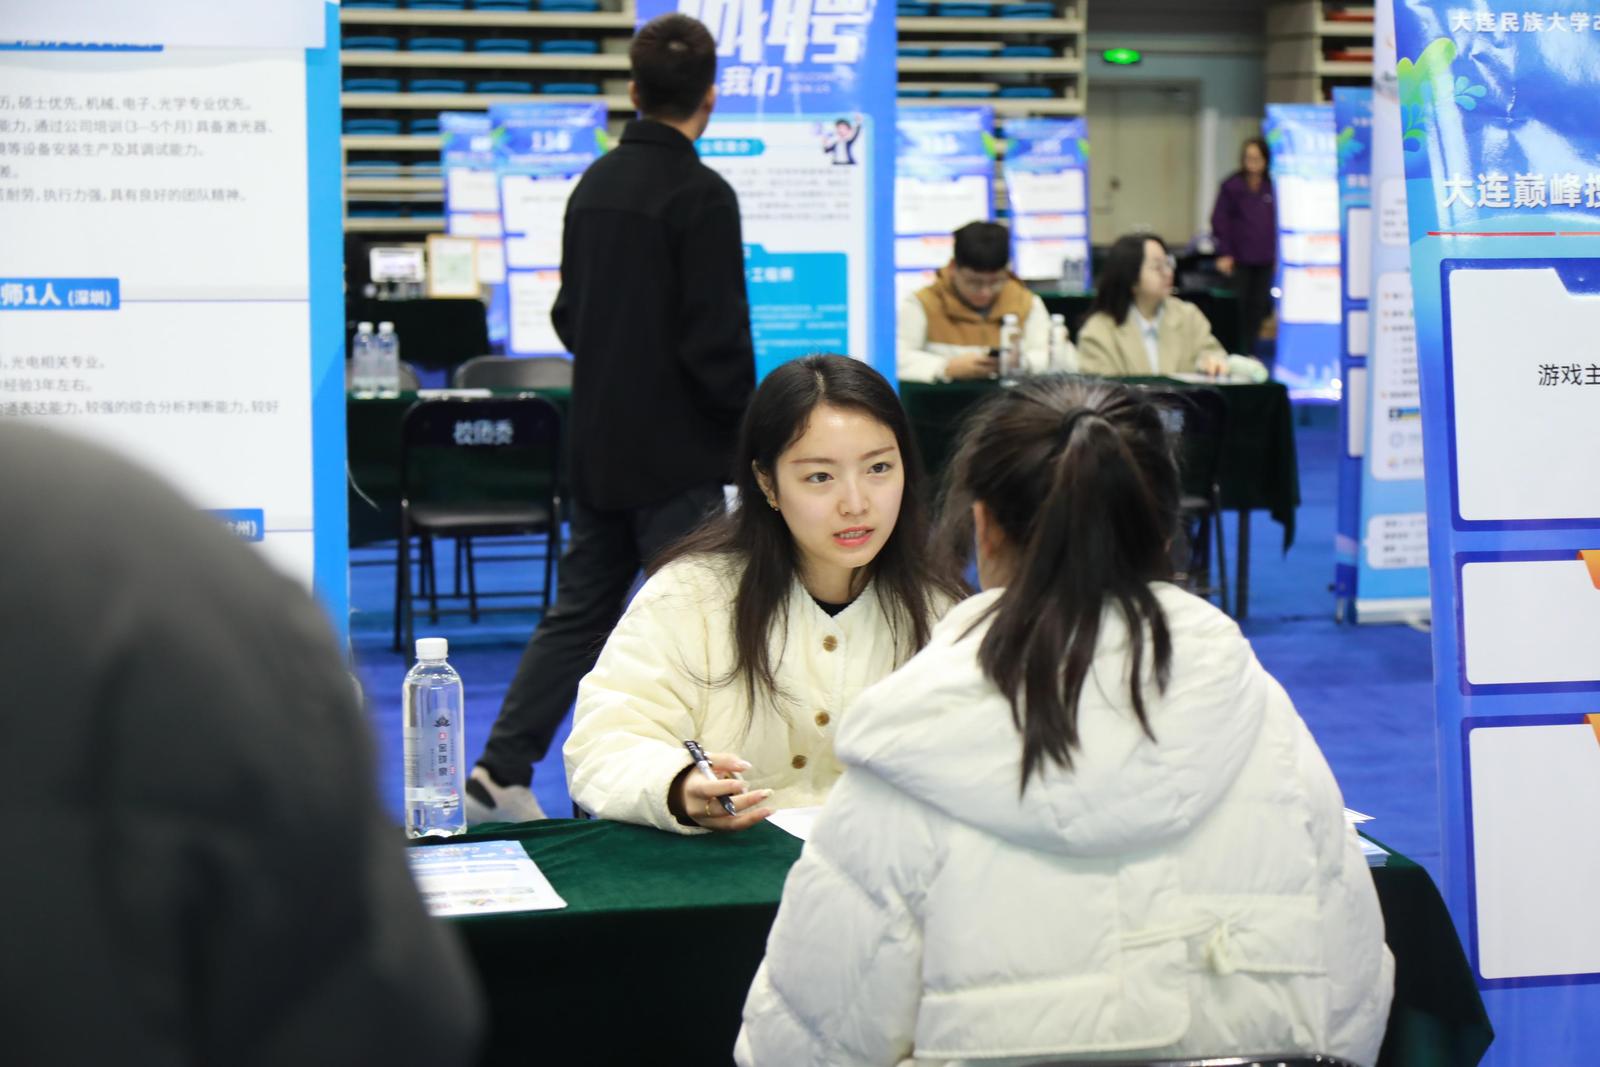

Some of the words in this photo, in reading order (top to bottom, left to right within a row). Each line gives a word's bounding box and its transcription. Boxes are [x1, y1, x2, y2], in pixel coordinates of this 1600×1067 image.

[714, 65, 783, 97] 我们
[1, 282, 61, 307] 师1人
[0, 378, 93, 392] 经验3年左右。
[1538, 363, 1600, 387] 游戏主
